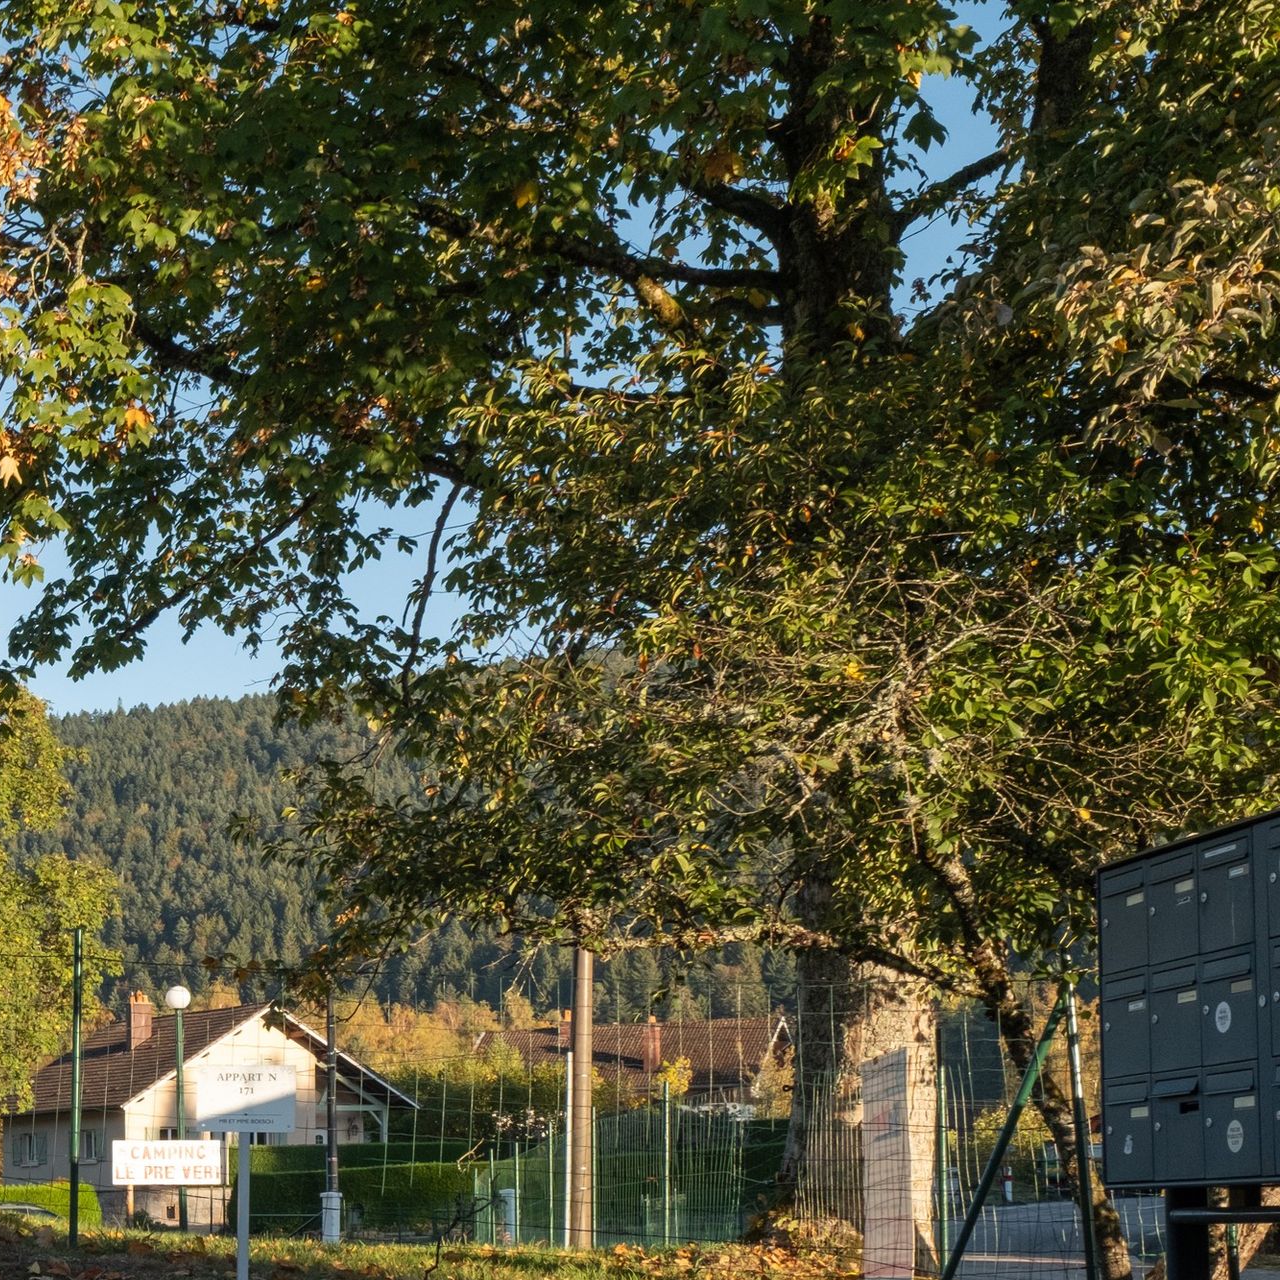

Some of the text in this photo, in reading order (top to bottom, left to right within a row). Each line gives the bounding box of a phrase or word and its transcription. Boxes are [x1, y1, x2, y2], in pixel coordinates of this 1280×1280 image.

[217, 1072, 263, 1082] APPART
[239, 1086, 254, 1096] 171
[130, 1145, 206, 1160] CAMPING
[115, 1165, 136, 1180] LE
[144, 1165, 176, 1180] PRE
